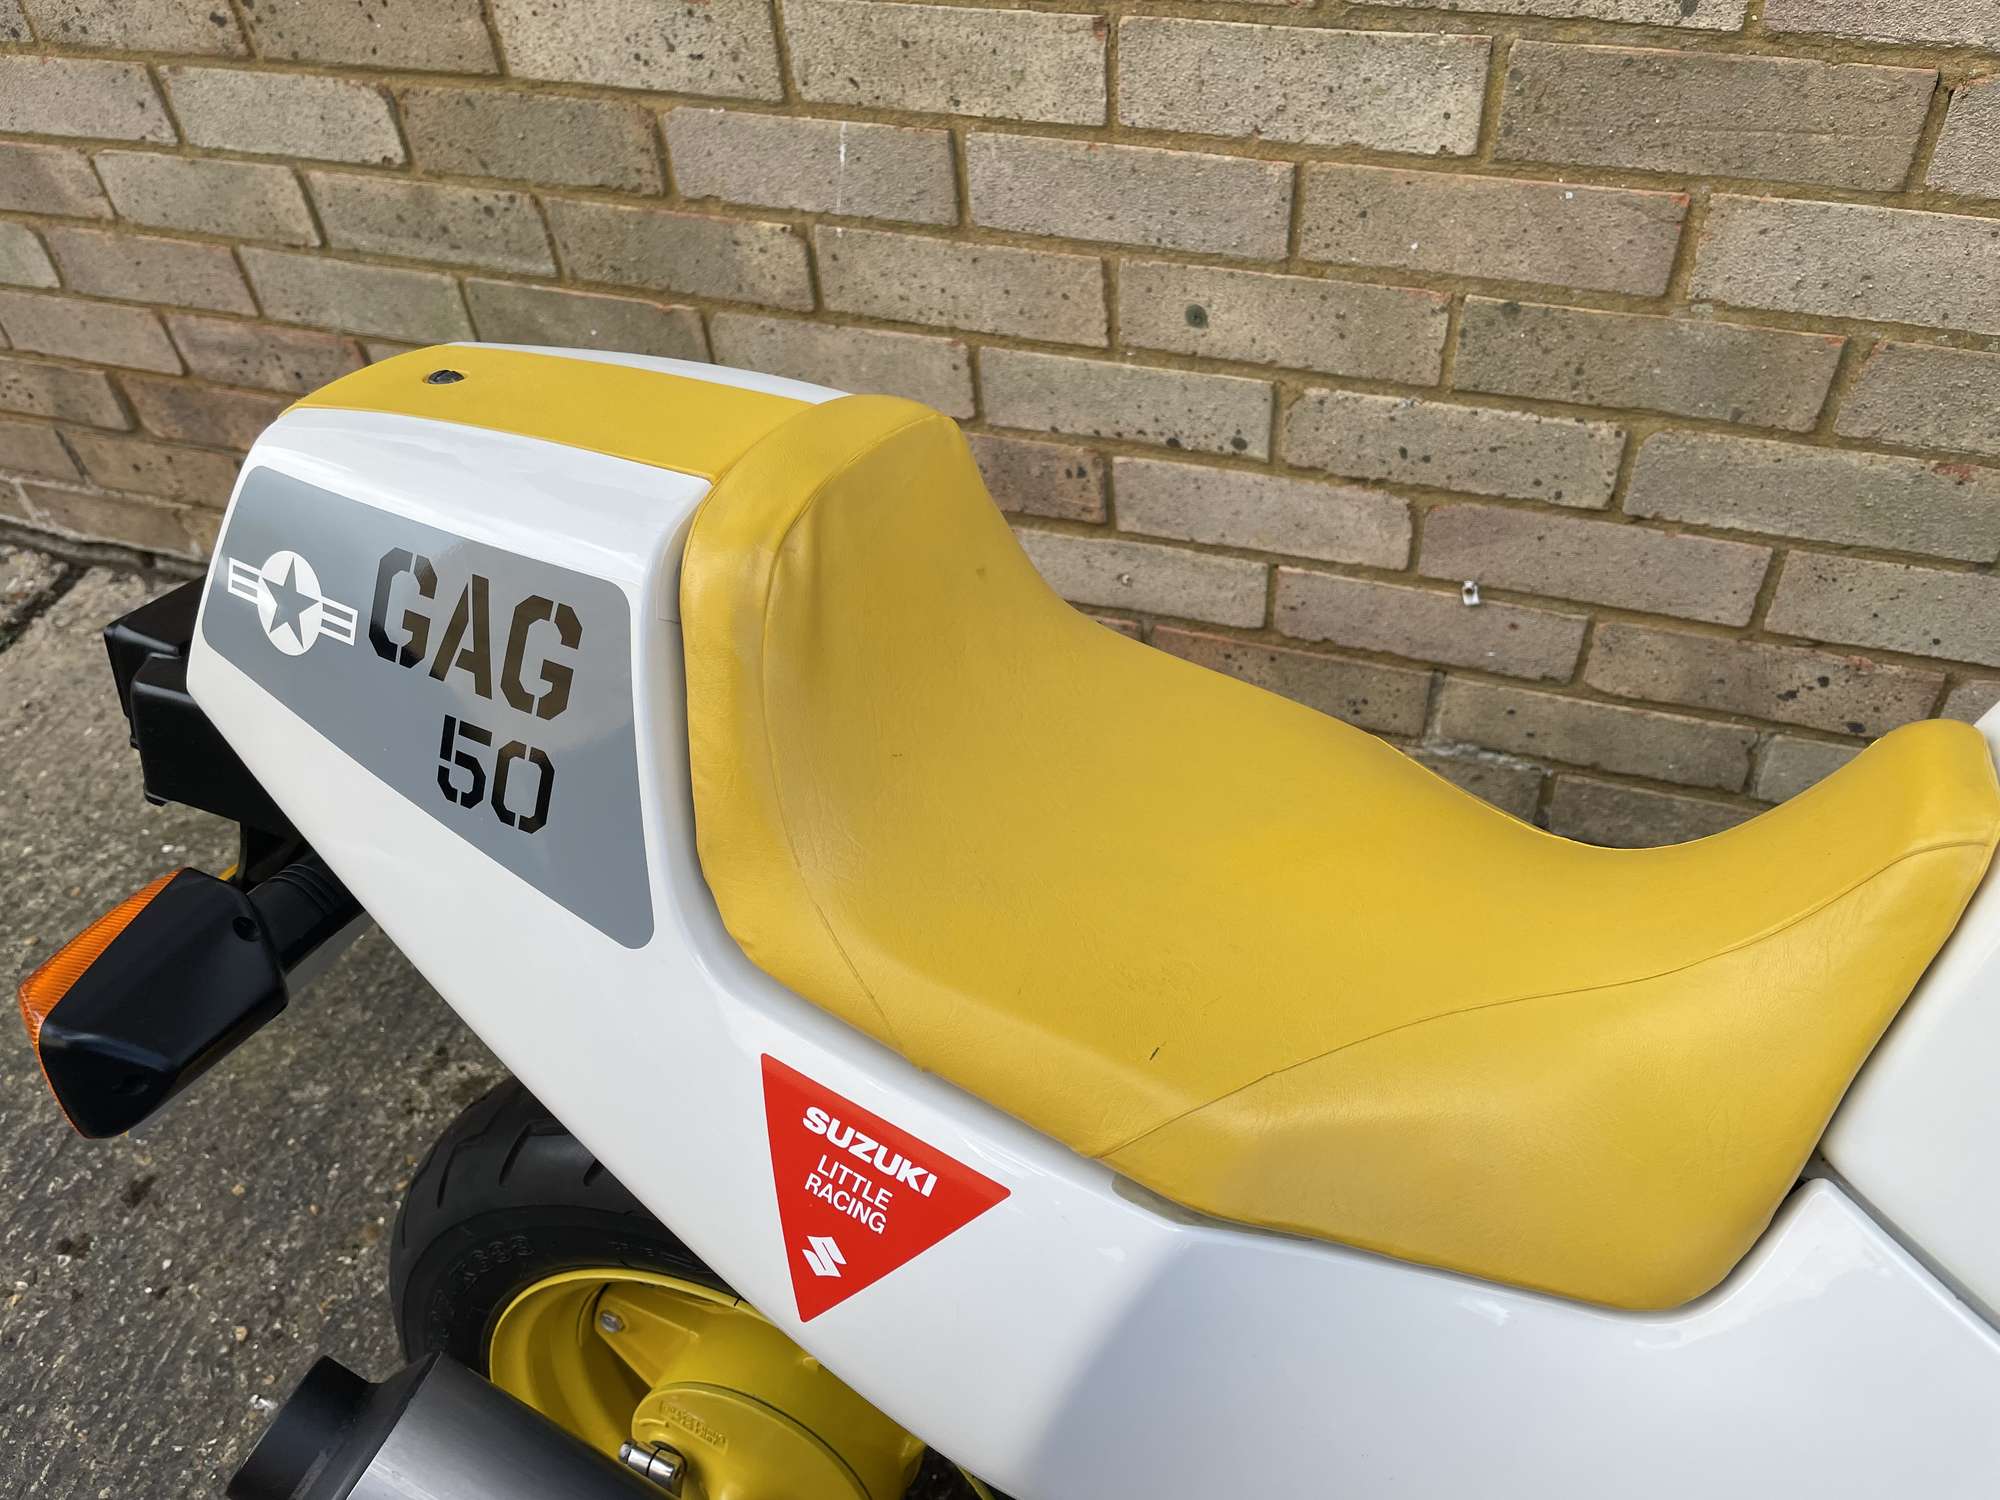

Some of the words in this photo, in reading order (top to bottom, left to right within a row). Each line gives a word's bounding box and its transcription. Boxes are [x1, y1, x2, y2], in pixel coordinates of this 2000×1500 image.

[368, 546, 584, 721] GAG
[436, 713, 556, 835] 50
[802, 1106, 938, 1198] SUZUKI
[816, 1154, 894, 1211] LITTLE
[804, 1172, 888, 1235] RACING
